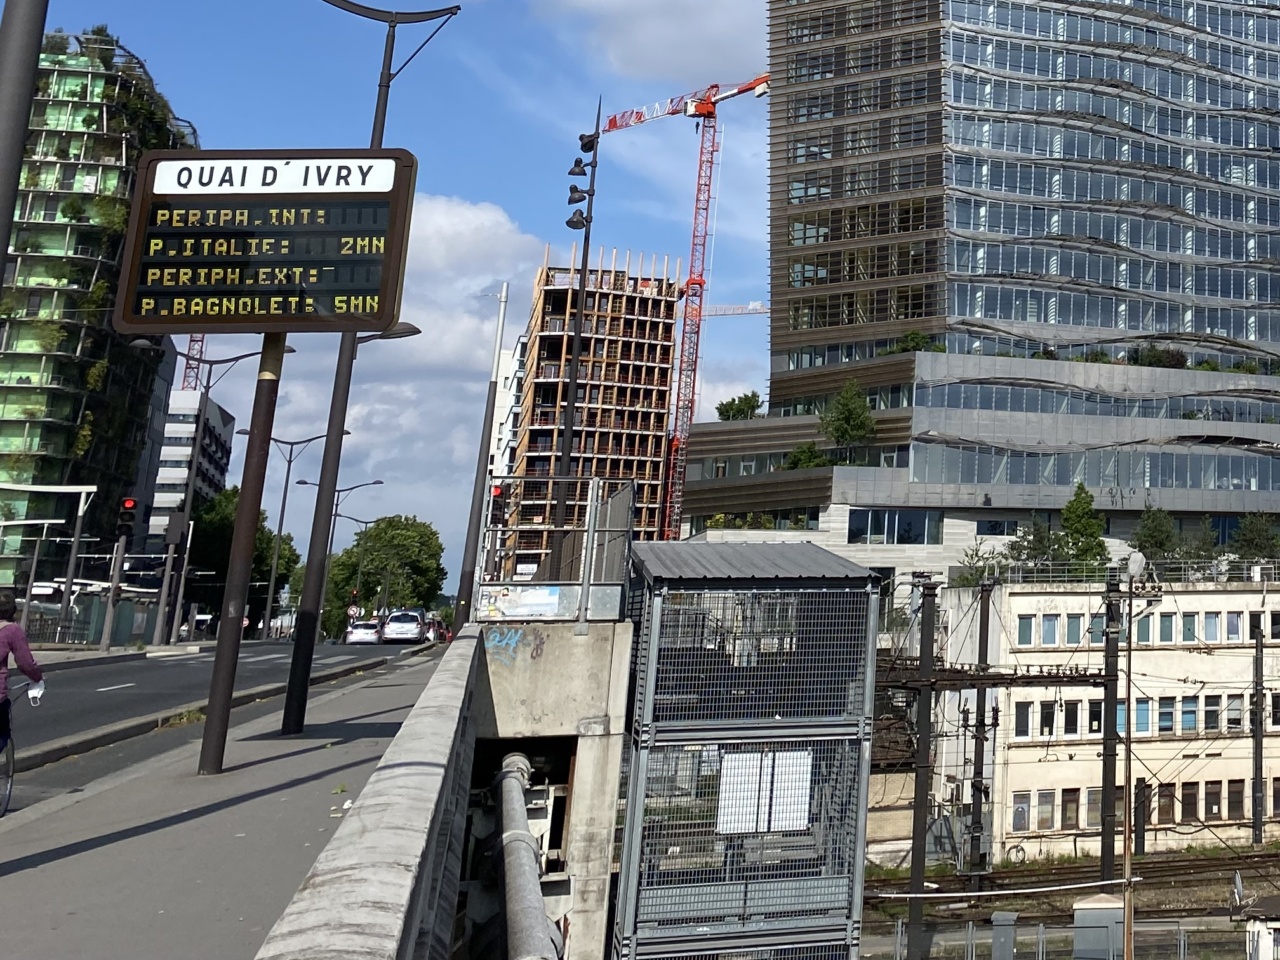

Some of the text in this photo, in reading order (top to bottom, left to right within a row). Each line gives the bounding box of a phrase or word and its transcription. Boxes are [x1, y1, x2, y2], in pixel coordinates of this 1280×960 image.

[176, 165, 247, 189] QUAI
[340, 236, 385, 255] 2MN
[334, 295, 379, 314] 5MN
